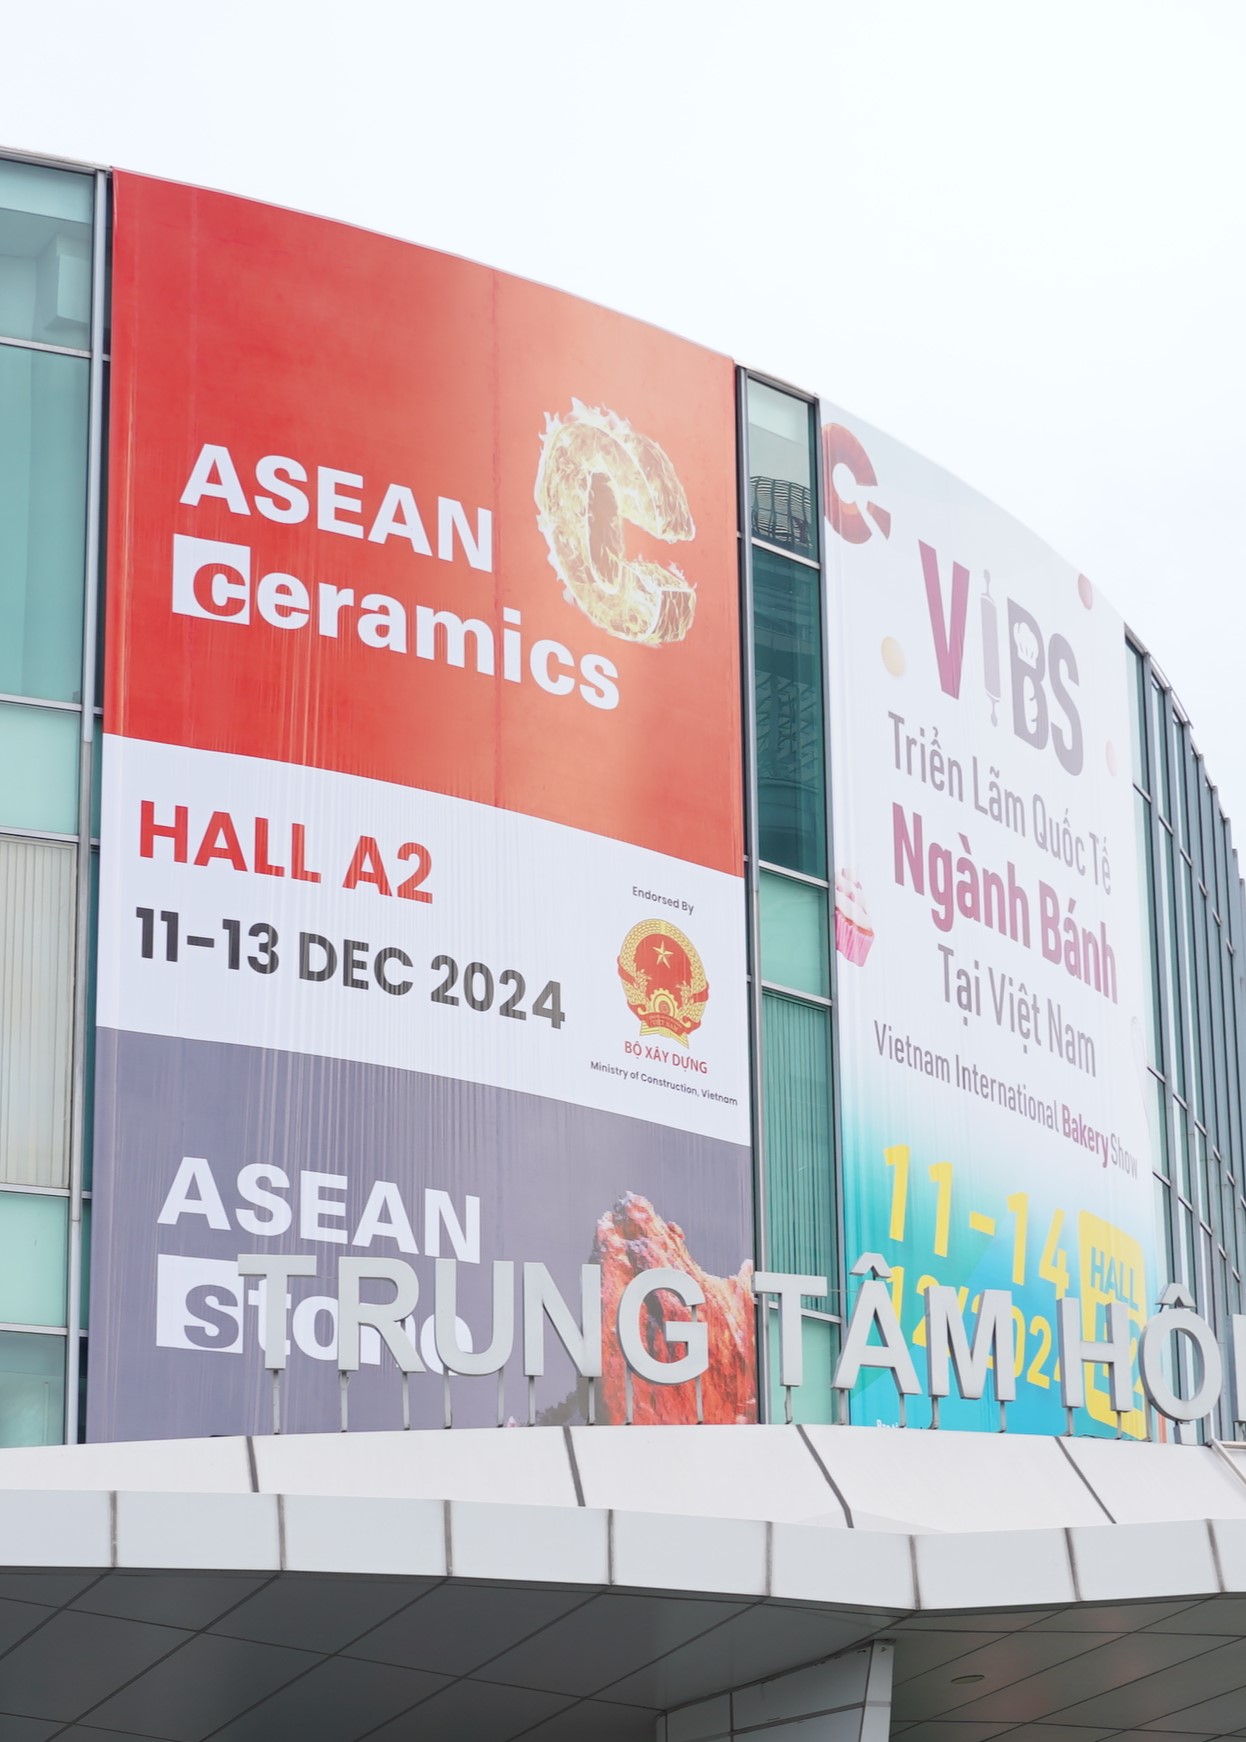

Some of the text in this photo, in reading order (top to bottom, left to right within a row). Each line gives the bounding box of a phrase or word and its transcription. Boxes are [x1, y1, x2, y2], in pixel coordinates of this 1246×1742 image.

[179, 443, 493, 573] ASEAN
[193, 561, 620, 711] ceramics
[140, 800, 433, 904] HALL A2
[888, 711, 1112, 895] Triển Lãm Quốc Tế
[632, 886, 694, 915] Endorsed By
[892, 802, 1118, 1006] Ngành Bánh
[136, 906, 566, 1030] 11-13 DEC 2024
[937, 944, 1096, 1077] Tại Việt Nam
[590, 1061, 738, 1106] Ministry of Construction, Vietnam
[625, 1040, 708, 1074] BỘ XÂY DỰNG
[874, 1020, 1138, 1180] Vietnam International Bakery Show
[157, 1156, 481, 1264] ASEAN
[884, 1144, 1071, 1299] 11-14
[237, 1254, 709, 1385] TRUNG
[752, 1252, 1016, 1402] TÂM
[1091, 1246, 1139, 1312] HALL
